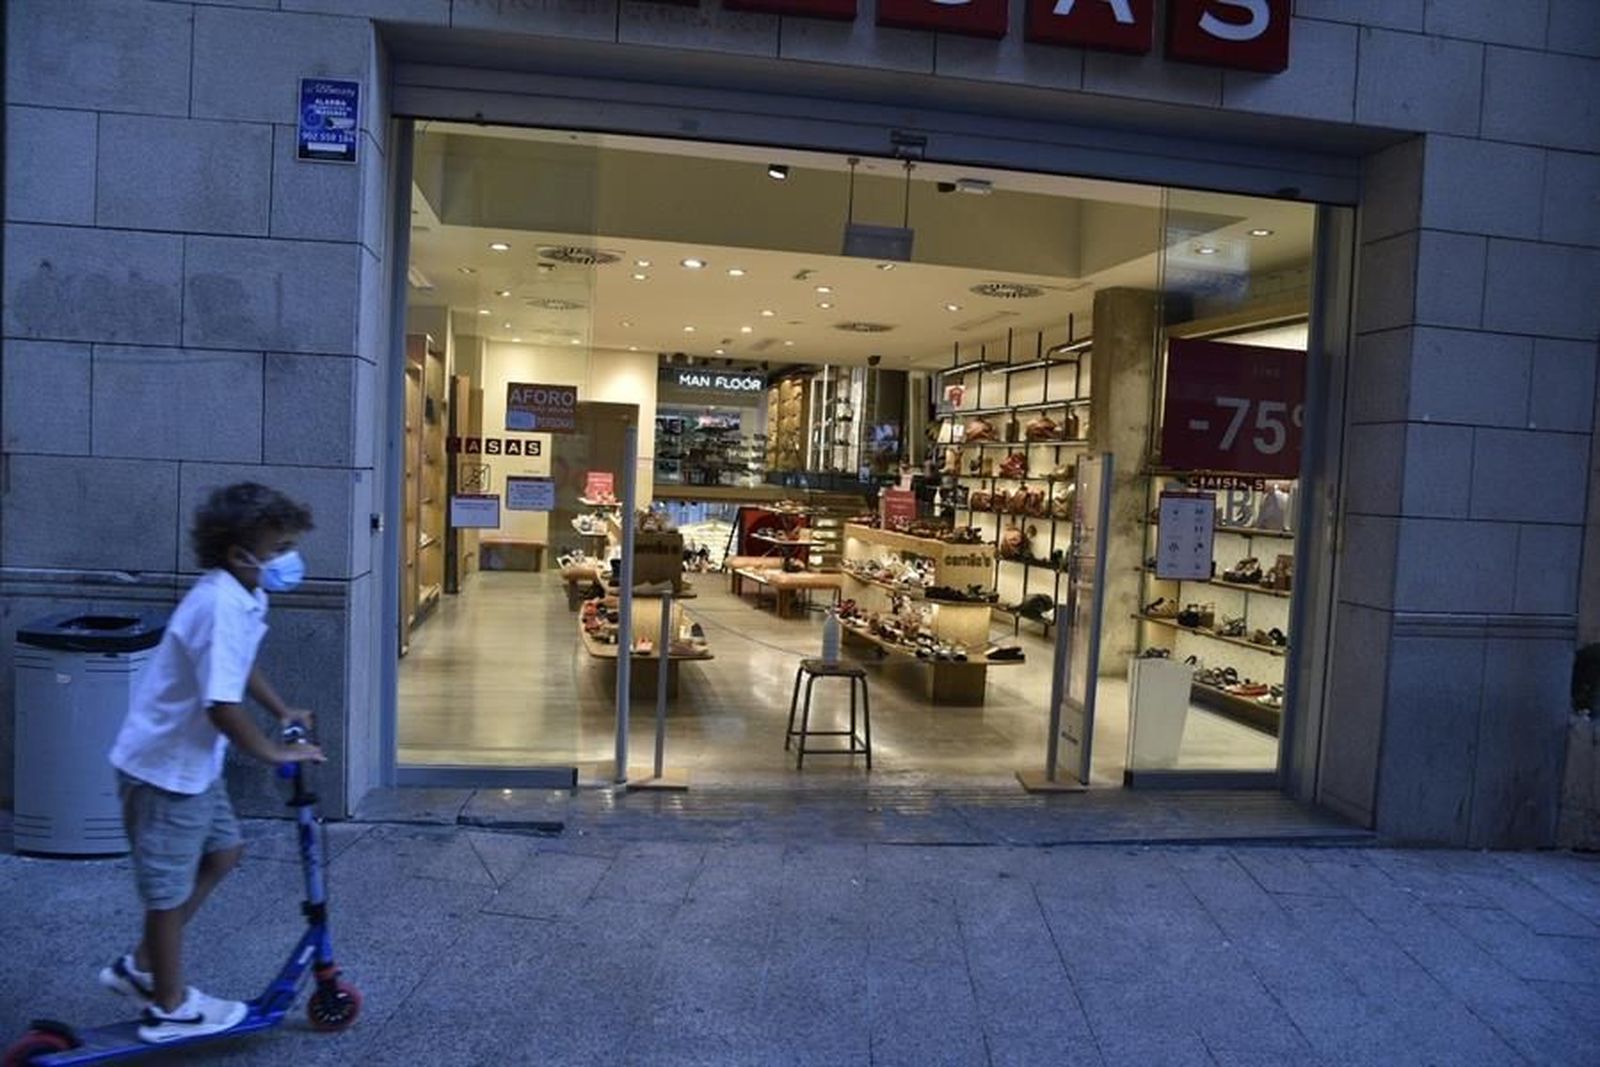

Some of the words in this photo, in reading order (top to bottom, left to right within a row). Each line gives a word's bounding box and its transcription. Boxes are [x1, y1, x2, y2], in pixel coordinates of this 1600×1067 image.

[679, 374, 710, 388] MAN
[715, 376, 762, 391] FLOOR
[510, 388, 574, 406] AFORO
[1189, 396, 1306, 455] -75
[450, 440, 539, 454] ASAS
